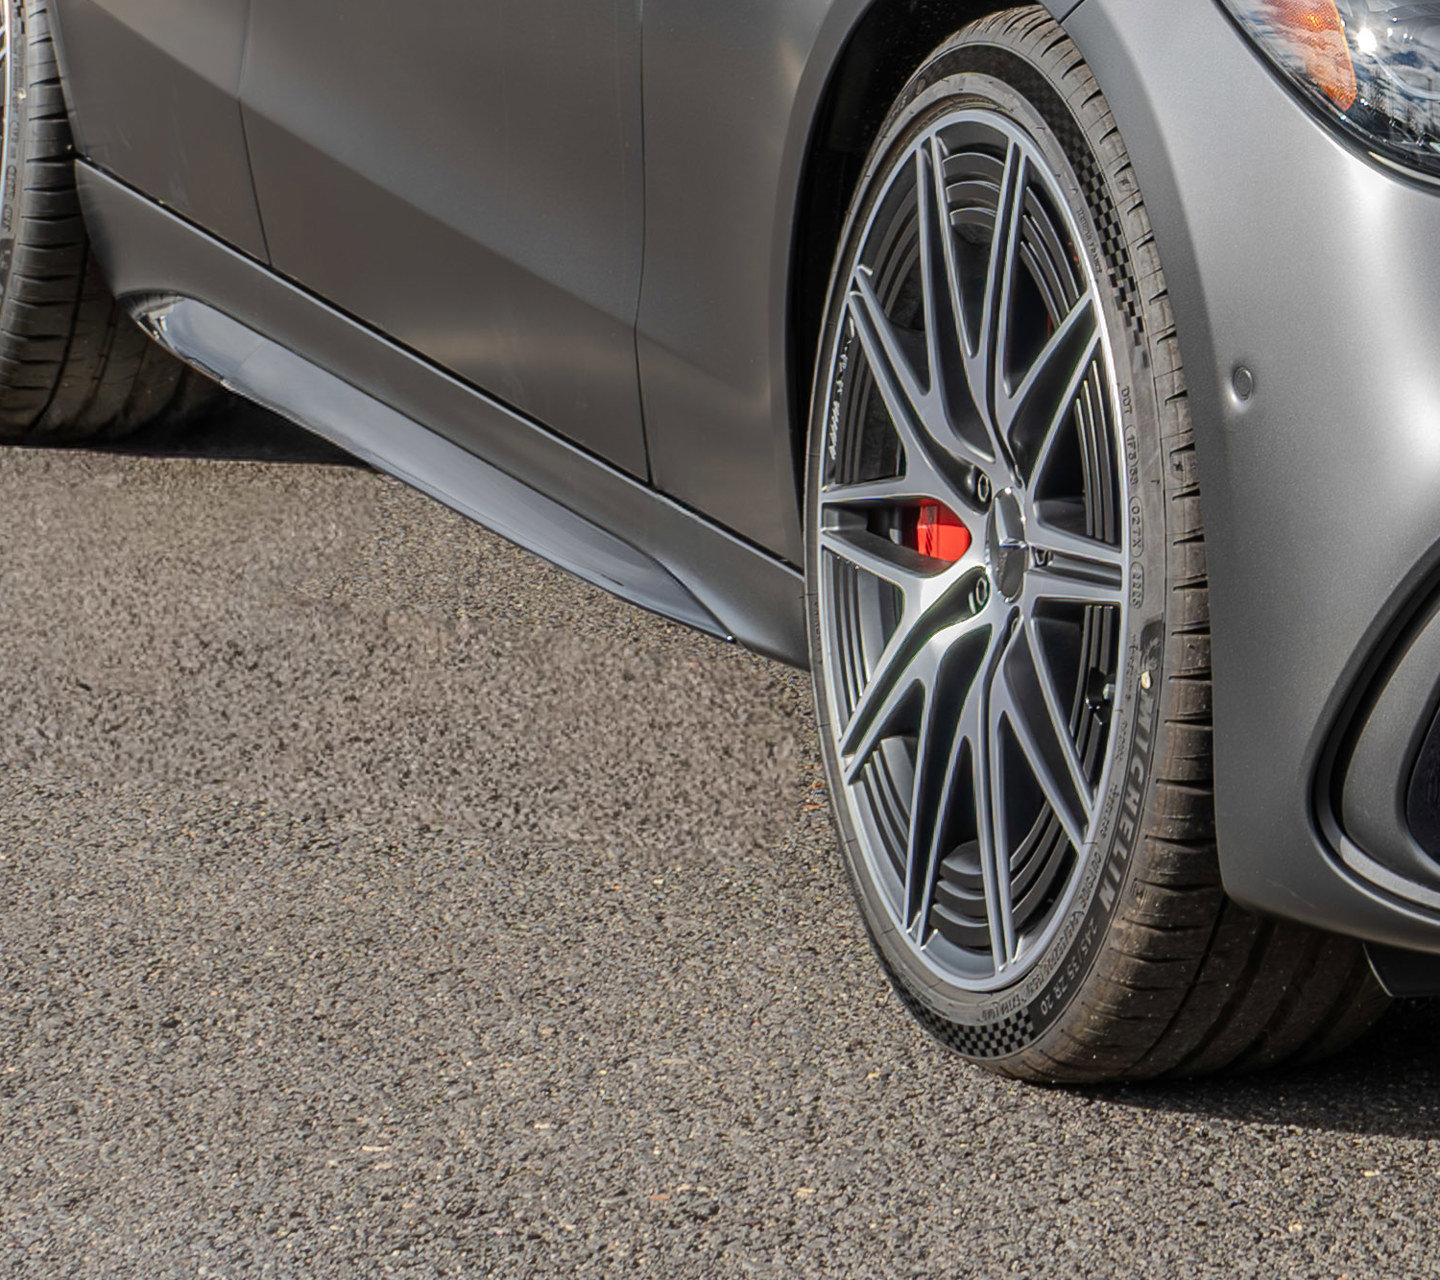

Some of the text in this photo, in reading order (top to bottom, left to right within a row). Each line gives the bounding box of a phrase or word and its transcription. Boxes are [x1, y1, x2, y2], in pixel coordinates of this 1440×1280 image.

[1121, 386, 1133, 415] DOT
[1098, 689, 1156, 913] MICHELIN
[1066, 917, 1099, 980] 245/35
